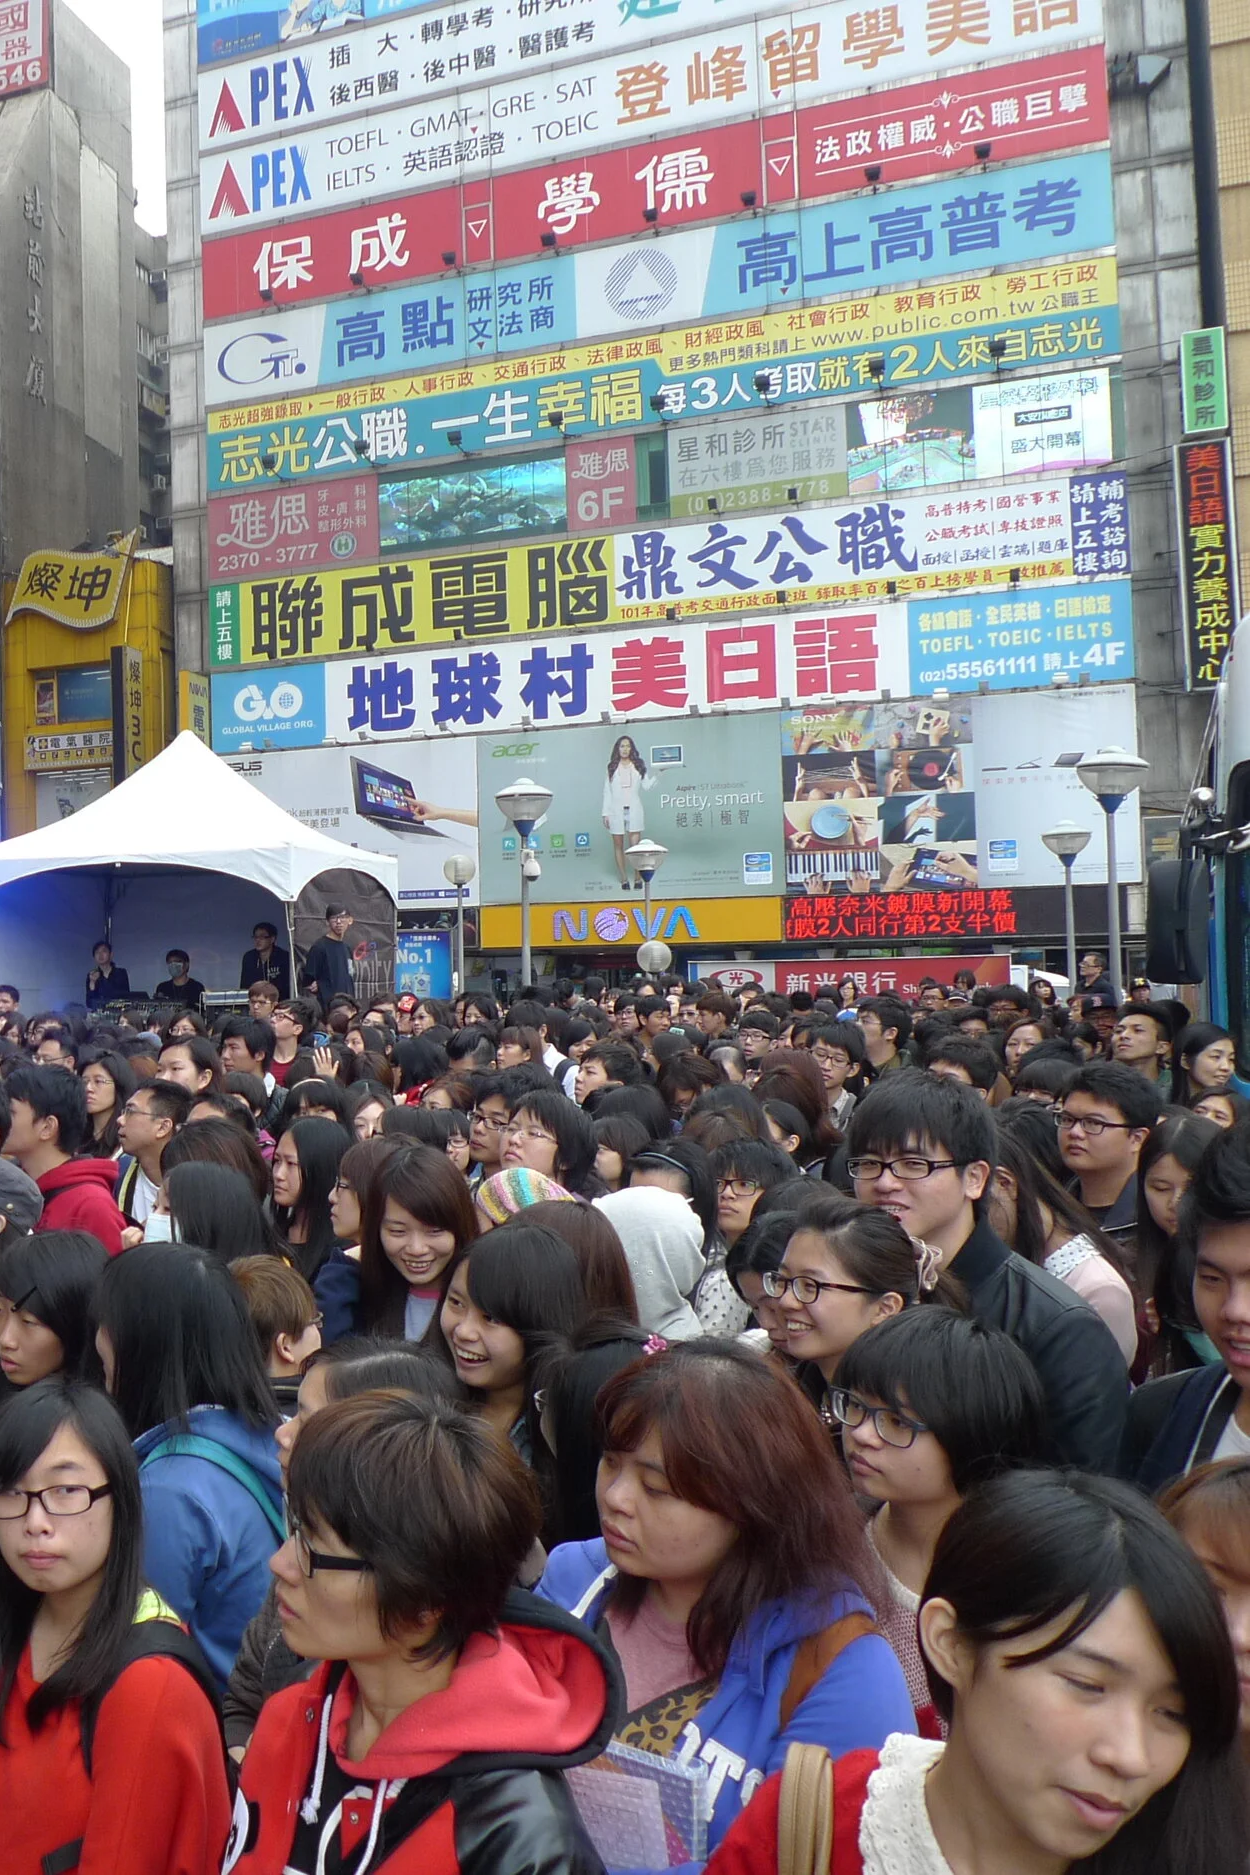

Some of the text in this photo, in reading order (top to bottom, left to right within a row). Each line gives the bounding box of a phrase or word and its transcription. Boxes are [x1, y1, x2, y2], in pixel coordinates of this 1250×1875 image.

[325, 76, 598, 159] TOEFL GMAT GRE SAT
[326, 111, 599, 192] IELTS 英語認證 TOEIC
[737, 177, 1082, 294] 高上高普考
[466, 275, 555, 311] 研究所
[335, 296, 455, 367] 高點
[466, 305, 555, 349] 文法商
[669, 288, 1100, 372] 更多熱門類科請上 www.public.com.tw 公職王
[1190, 335, 1216, 427] 星和診所
[218, 402, 303, 429] 志光超強錄取
[677, 416, 837, 463] 星和診所 STAR
[790, 433, 837, 448] CLINIC
[1011, 430, 1082, 454] 盛大開幕
[577, 486, 625, 521] 6F
[687, 479, 830, 516] (0)2388-7778
[925, 523, 991, 543] 公職考試
[1070, 484, 1099, 573] 請上五樓
[1098, 479, 1128, 570] 輔考諮詢
[615, 502, 919, 601] 鼎文公職
[22, 561, 112, 613] 燦坤
[250, 538, 609, 661] 聯成電腦
[215, 590, 233, 661] 請上五樓
[919, 621, 1113, 655] TOEFL TOEIC IELTS
[222, 726, 256, 735] GLOBAL
[257, 723, 292, 733] VILLAGE
[790, 713, 839, 725] SONY
[50, 732, 111, 750] 電氣醫院
[492, 743, 541, 757] acer
[659, 790, 765, 811] Pretty, smart
[676, 812, 704, 829] 絕美
[553, 905, 700, 942] NOVA
[395, 948, 434, 965] No.1
